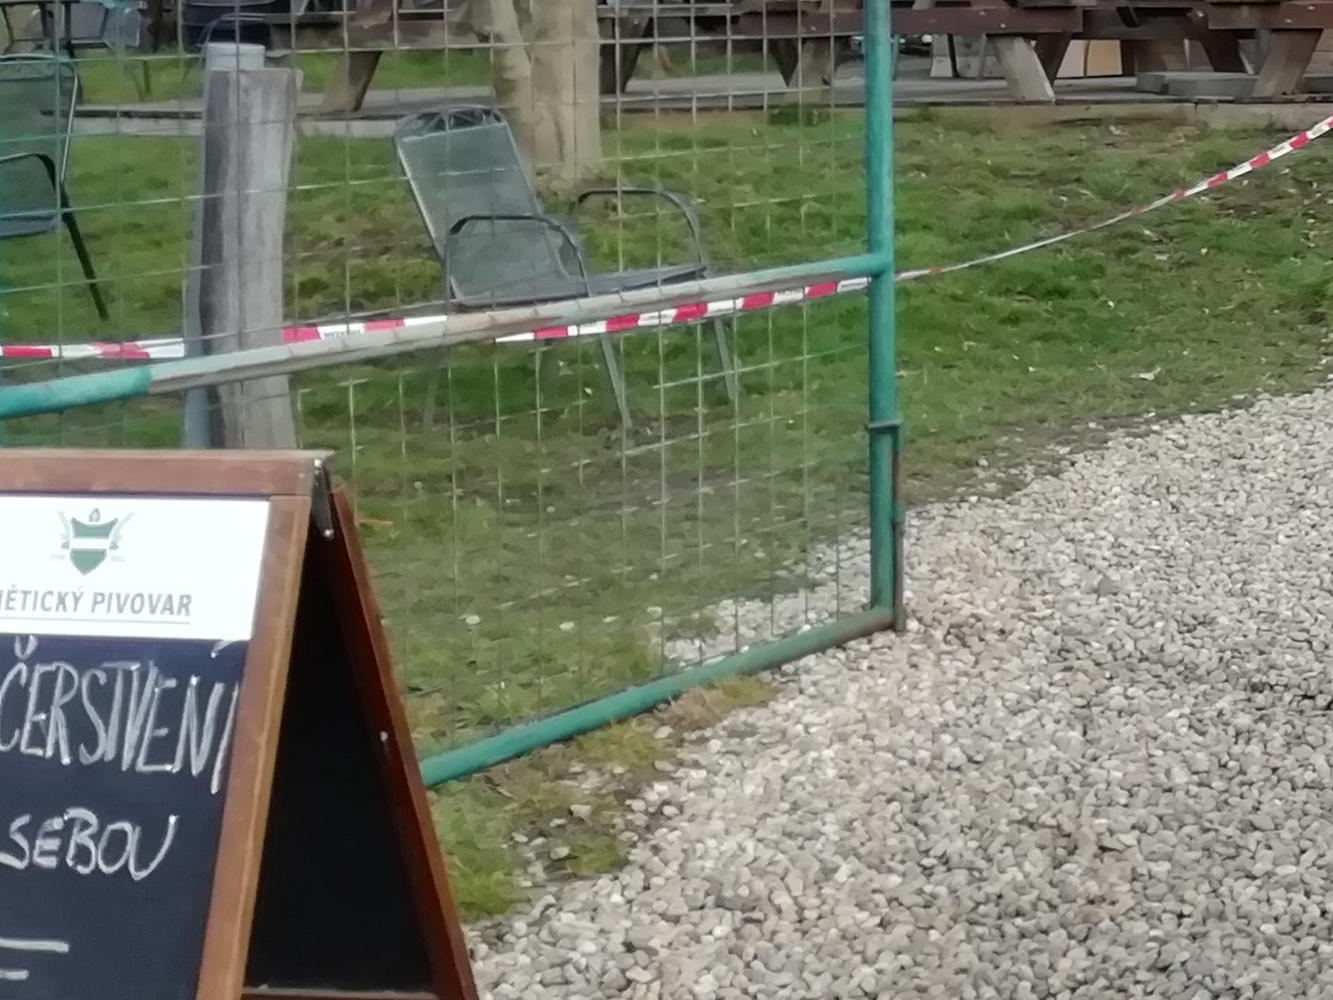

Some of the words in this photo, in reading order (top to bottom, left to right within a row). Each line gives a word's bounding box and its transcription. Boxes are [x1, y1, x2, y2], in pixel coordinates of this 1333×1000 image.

[0, 584, 85, 613] ĚTICKÝ
[90, 591, 193, 617] PIVOVAR
[0, 807, 180, 881] SEBOU
